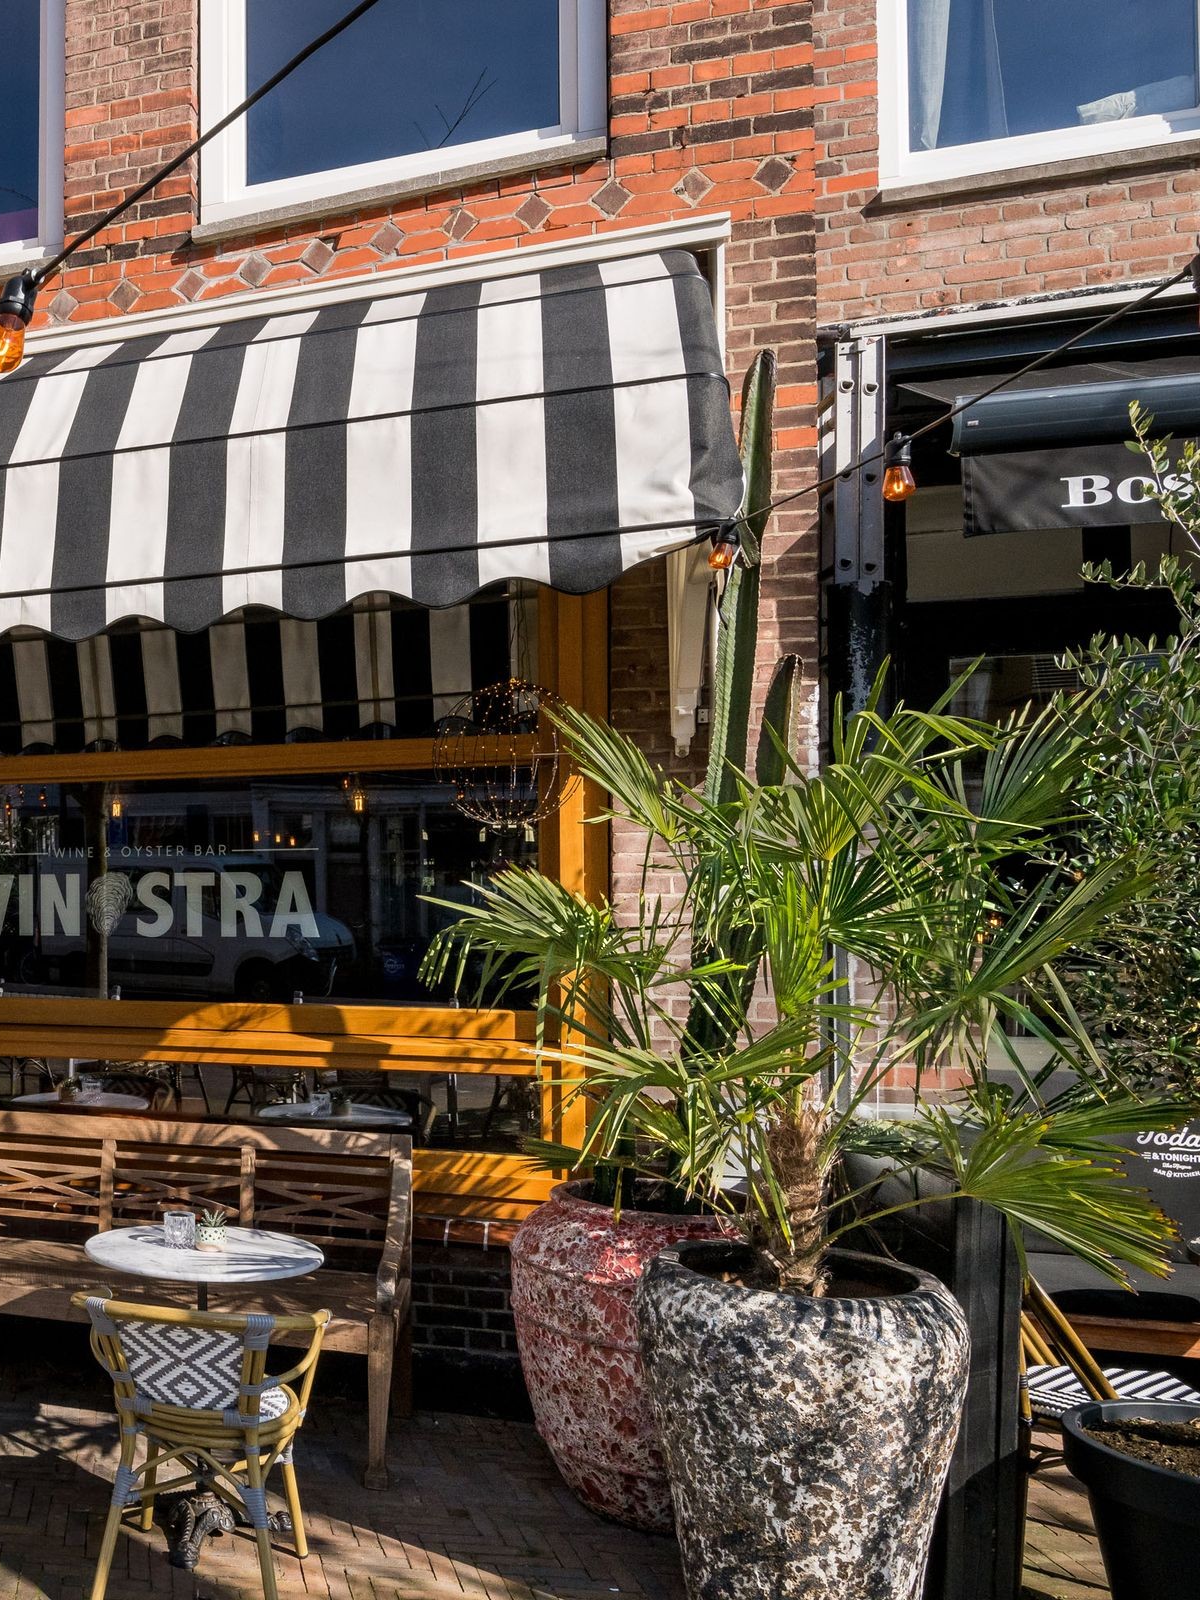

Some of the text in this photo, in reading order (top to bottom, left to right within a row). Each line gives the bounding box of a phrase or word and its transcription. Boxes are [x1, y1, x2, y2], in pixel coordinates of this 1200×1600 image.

[53, 844, 227, 859] WINE & OYSTER BAR
